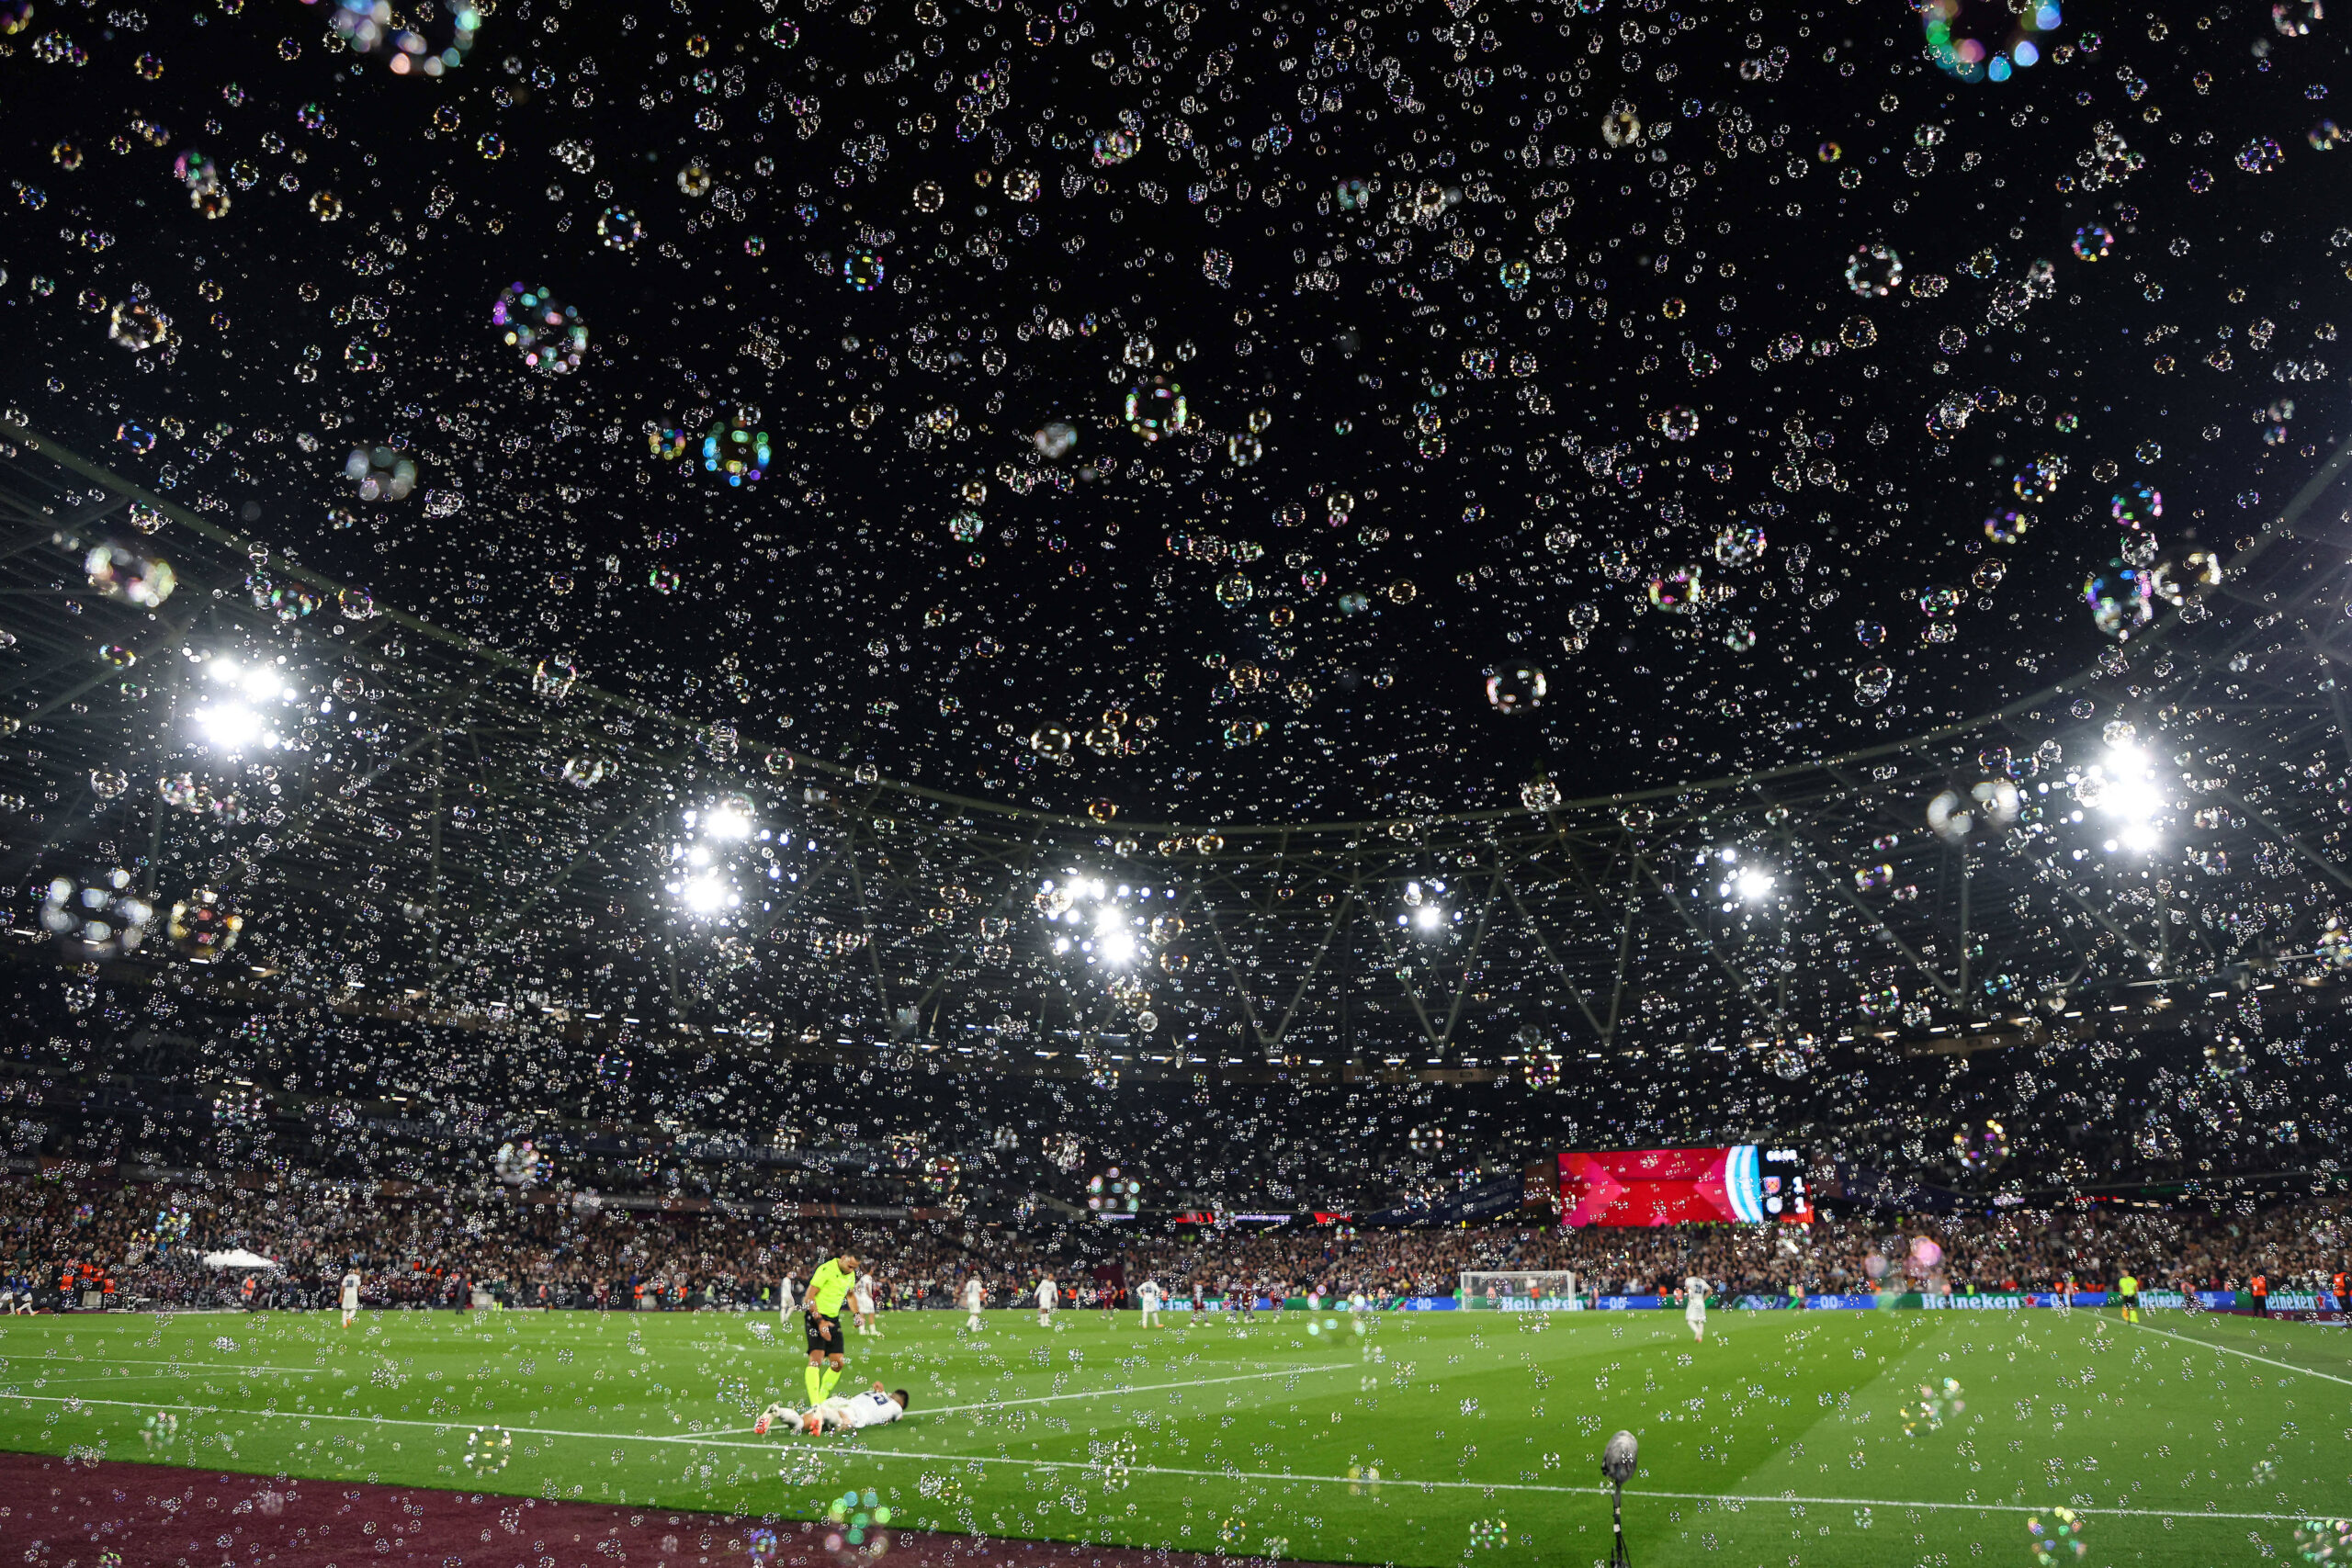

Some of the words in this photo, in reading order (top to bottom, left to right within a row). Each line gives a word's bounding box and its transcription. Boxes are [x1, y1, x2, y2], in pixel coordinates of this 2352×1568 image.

[1792, 1176, 1805, 1193] 1
[1795, 1196, 1807, 1213] 1
[1920, 1292, 2021, 1310] Heineken
[2137, 1291, 2187, 1309] Heineke
